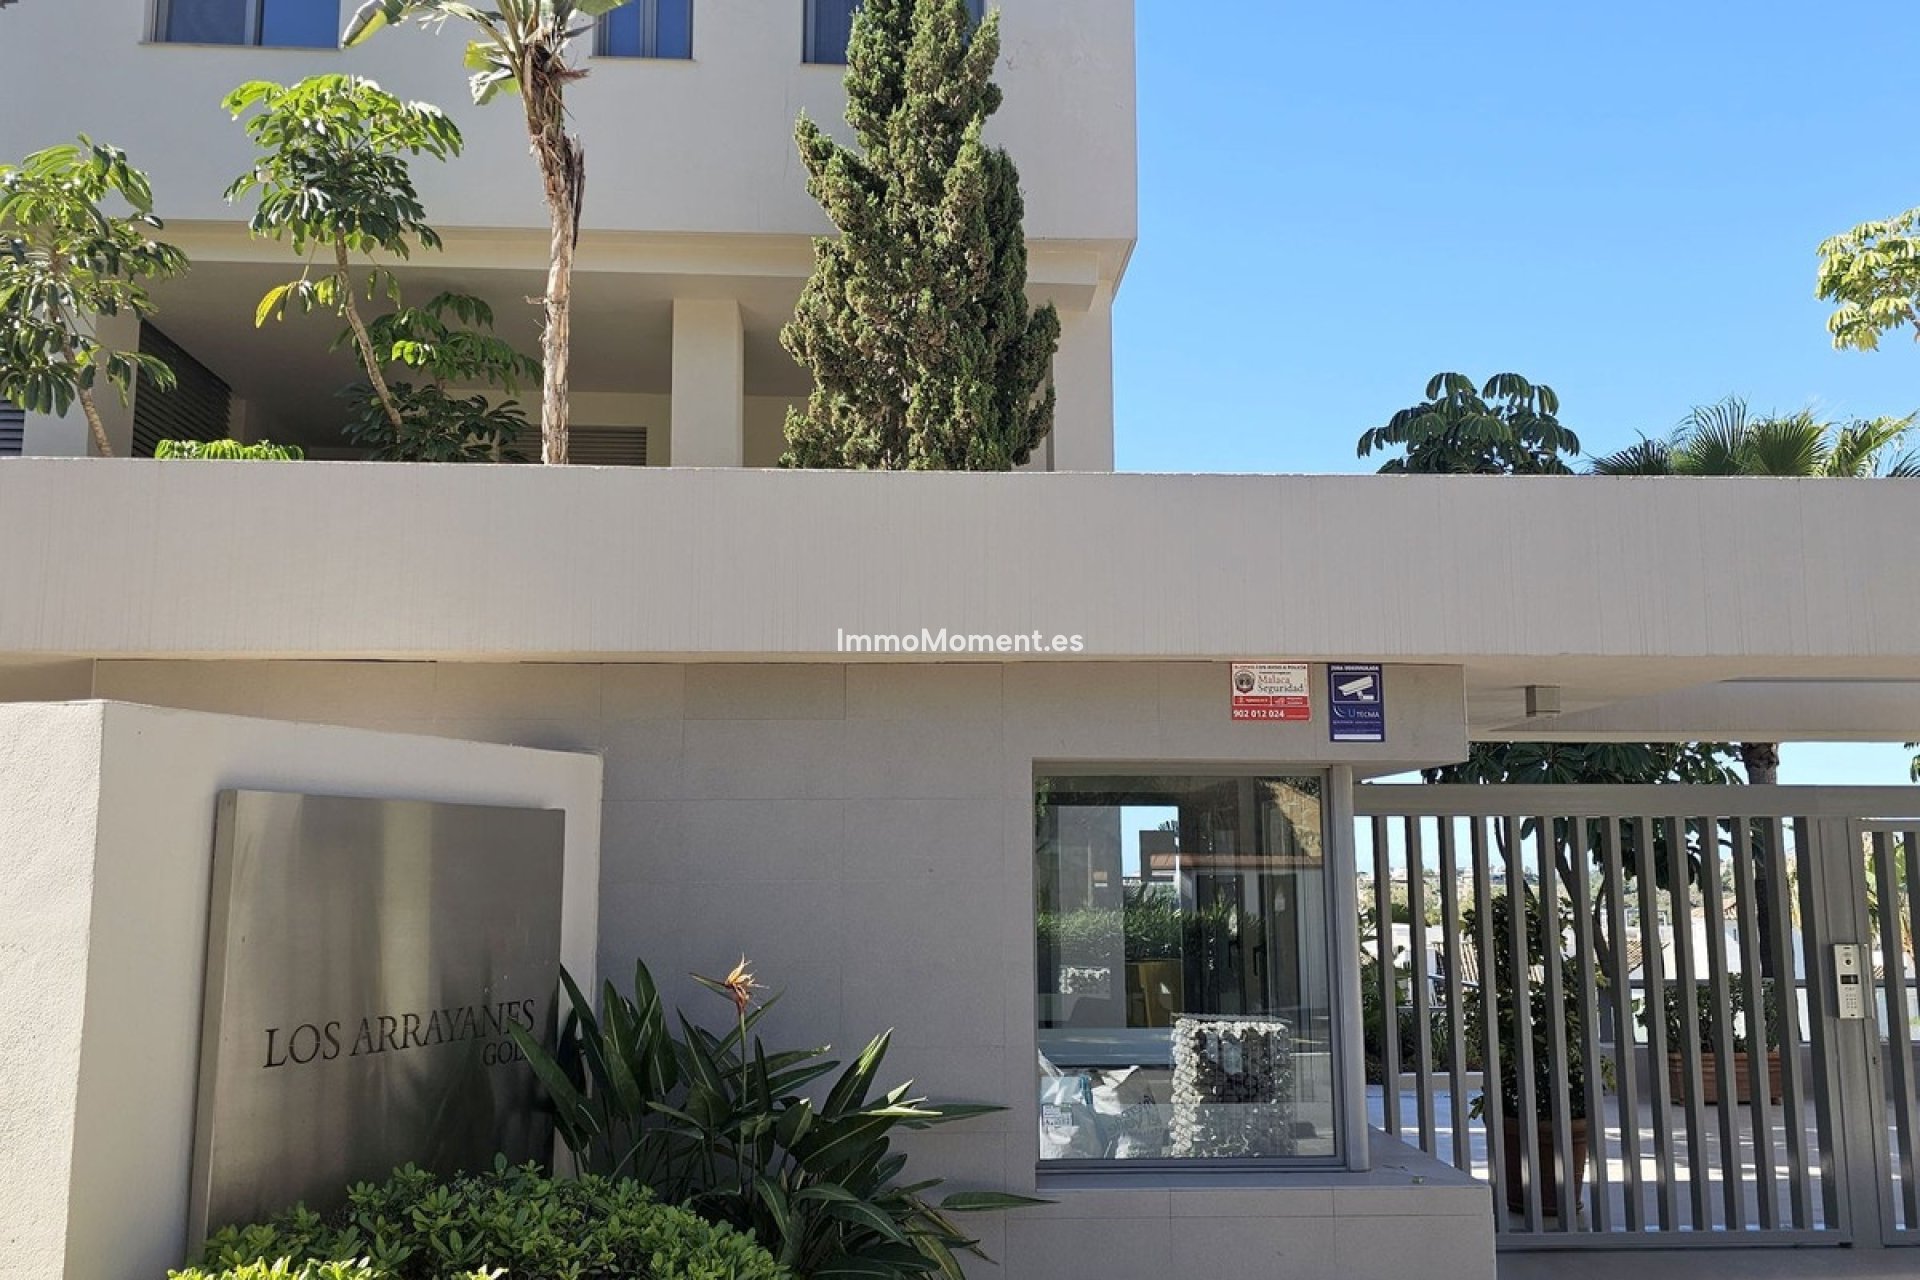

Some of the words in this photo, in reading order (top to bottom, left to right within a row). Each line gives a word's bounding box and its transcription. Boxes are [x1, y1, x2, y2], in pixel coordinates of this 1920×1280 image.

[1257, 683, 1304, 694] Seguridad
[1233, 709, 1249, 718] 902
[1250, 709, 1267, 718] 012
[1268, 709, 1284, 718] 024
[263, 1021, 341, 1068] LOS
[482, 1041, 528, 1066] GOL
